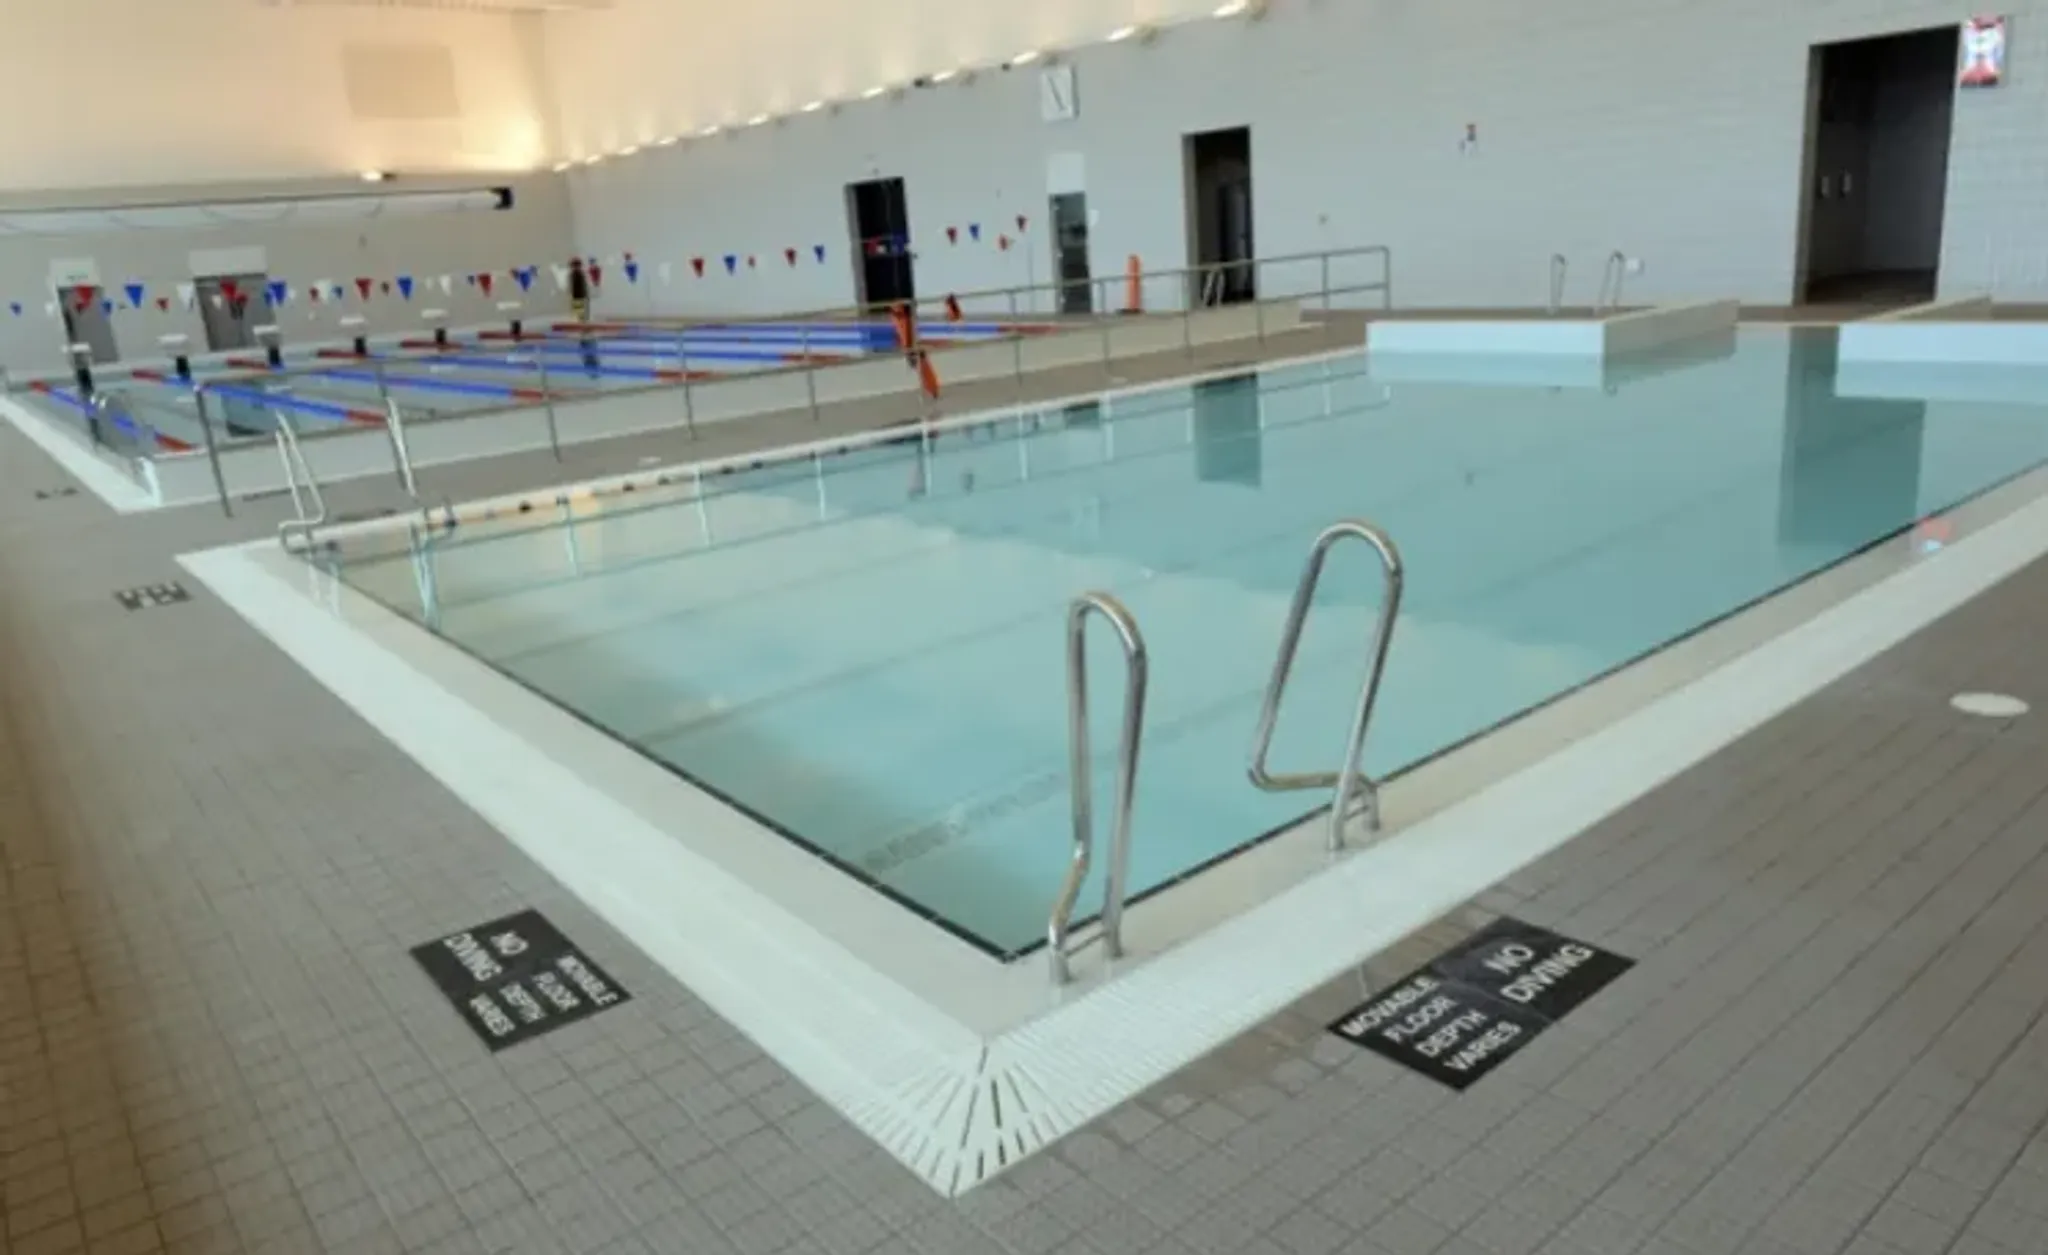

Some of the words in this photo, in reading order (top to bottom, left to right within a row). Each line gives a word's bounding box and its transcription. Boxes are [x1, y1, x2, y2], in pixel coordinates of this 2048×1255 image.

[1485, 944, 1533, 975] NO
[1502, 944, 1595, 1004] DIVING
[1339, 976, 1440, 1037] MOVABLE
[1382, 996, 1455, 1044] FLOOR
[1414, 1009, 1488, 1057] DEPTH
